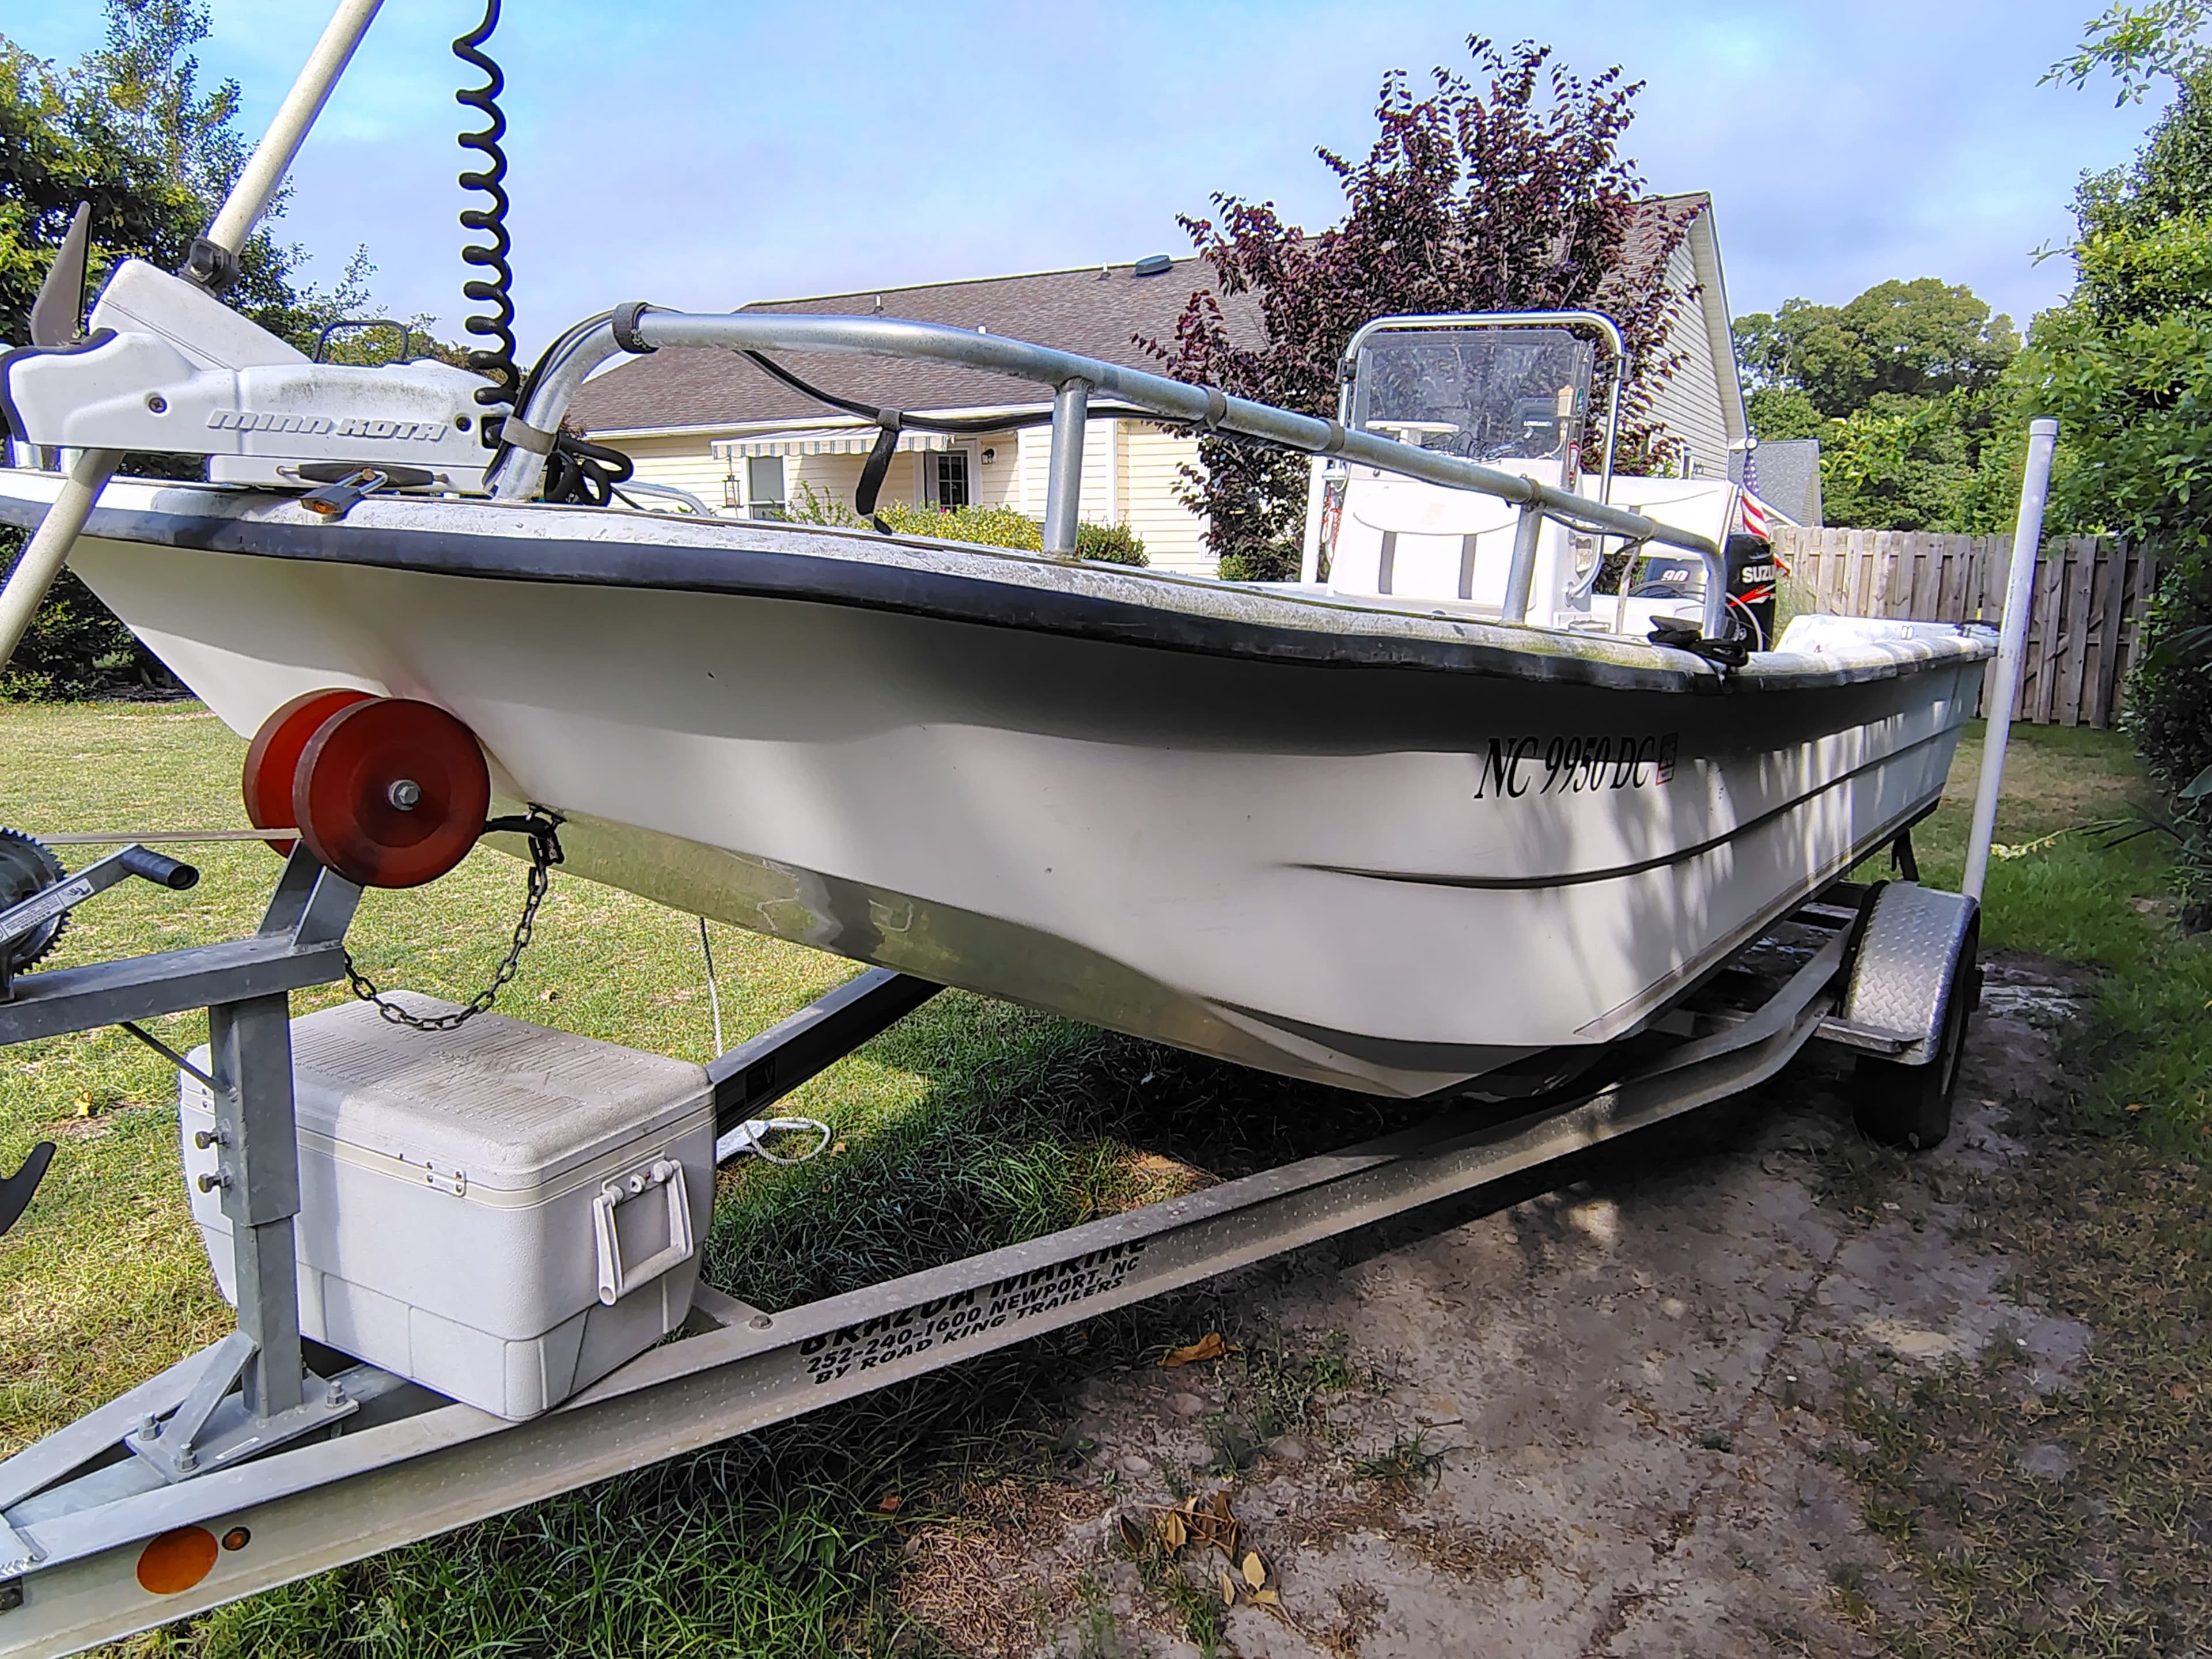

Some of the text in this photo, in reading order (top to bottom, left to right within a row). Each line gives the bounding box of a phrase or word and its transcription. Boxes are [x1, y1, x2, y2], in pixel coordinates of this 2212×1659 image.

[336, 418, 447, 441] KOTA
[1661, 570, 1690, 581] 90
[1474, 736, 1539, 798] NC
[1540, 736, 1611, 794] 9950
[1610, 736, 1655, 789] DC
[806, 1307, 982, 1373] 252-240-1600
[1111, 1256, 1139, 1277] NC
[815, 1275, 1125, 1384] BY ROAD KING TRAILERS
